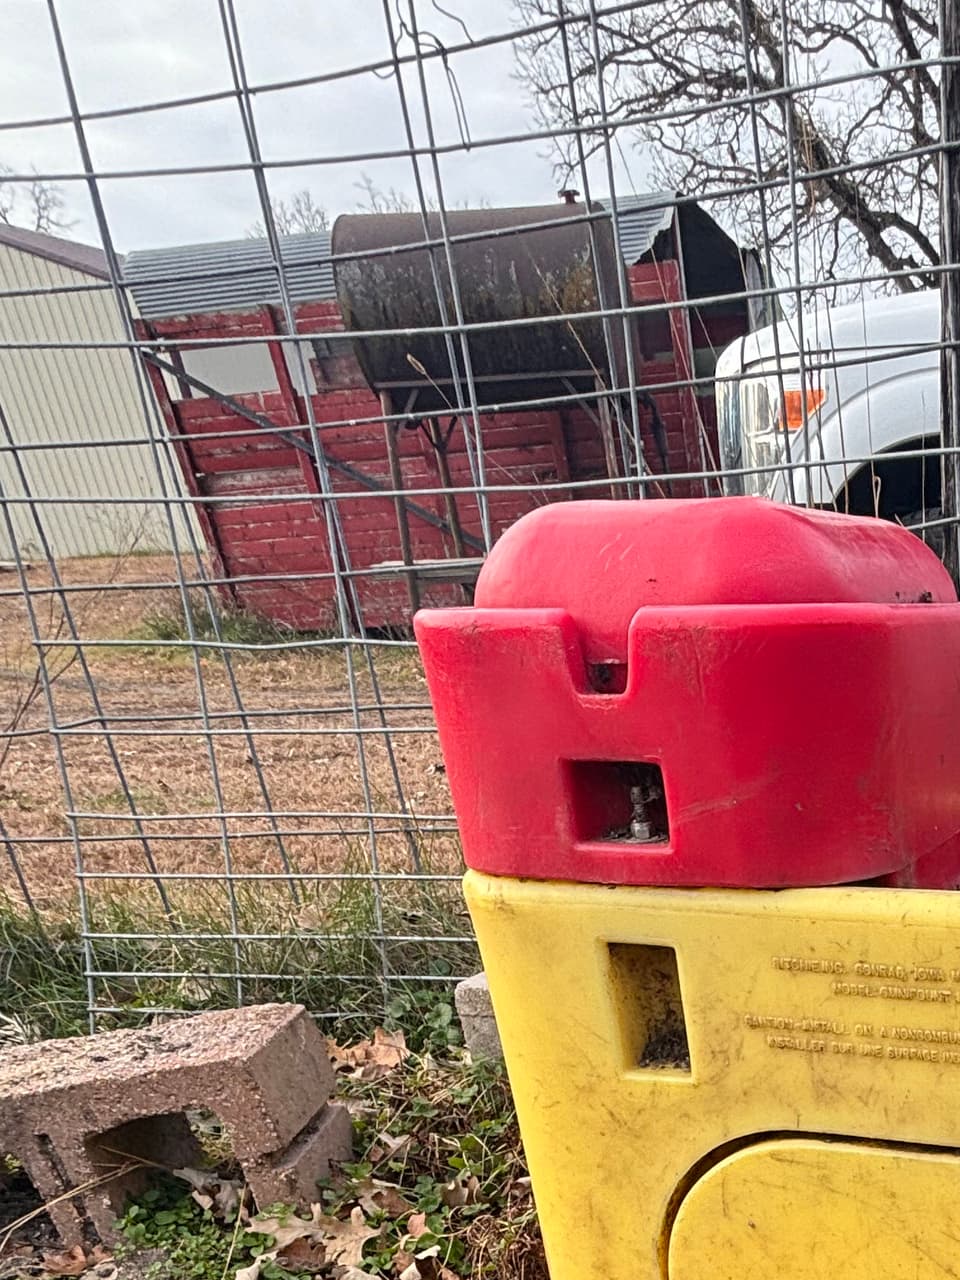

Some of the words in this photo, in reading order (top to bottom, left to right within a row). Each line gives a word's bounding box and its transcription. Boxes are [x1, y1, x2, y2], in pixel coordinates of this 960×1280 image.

[855, 1024, 873, 1036] ON
[880, 1026, 888, 1038] A
[860, 1044, 882, 1057] UNE
[887, 1046, 938, 1062] SURFACE
